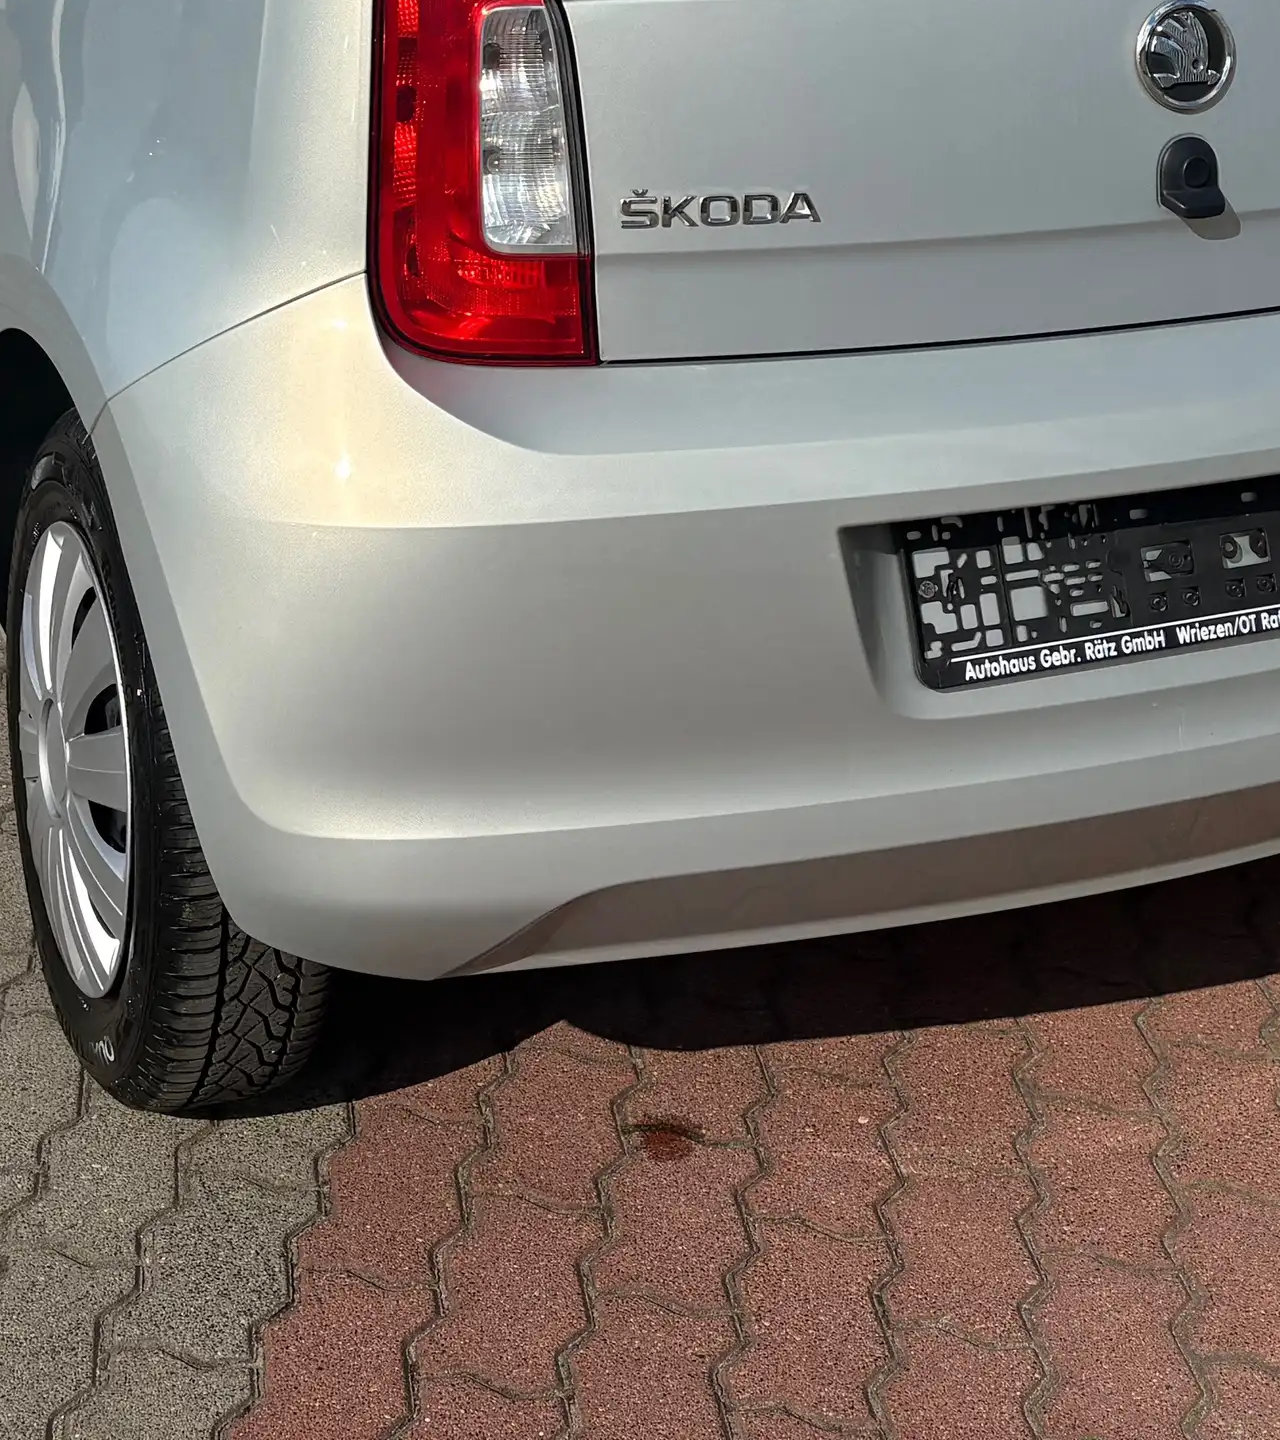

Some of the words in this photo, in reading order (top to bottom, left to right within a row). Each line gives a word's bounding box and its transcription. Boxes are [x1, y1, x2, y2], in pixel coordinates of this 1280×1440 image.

[620, 188, 821, 229] ŠKODA
[964, 655, 1037, 681] Autohaus
[1040, 648, 1082, 668] Gebr.
[1084, 639, 1118, 661] Rätz
[1121, 630, 1166, 654] GmbH
[1176, 614, 1257, 645] Wriezen/OT
